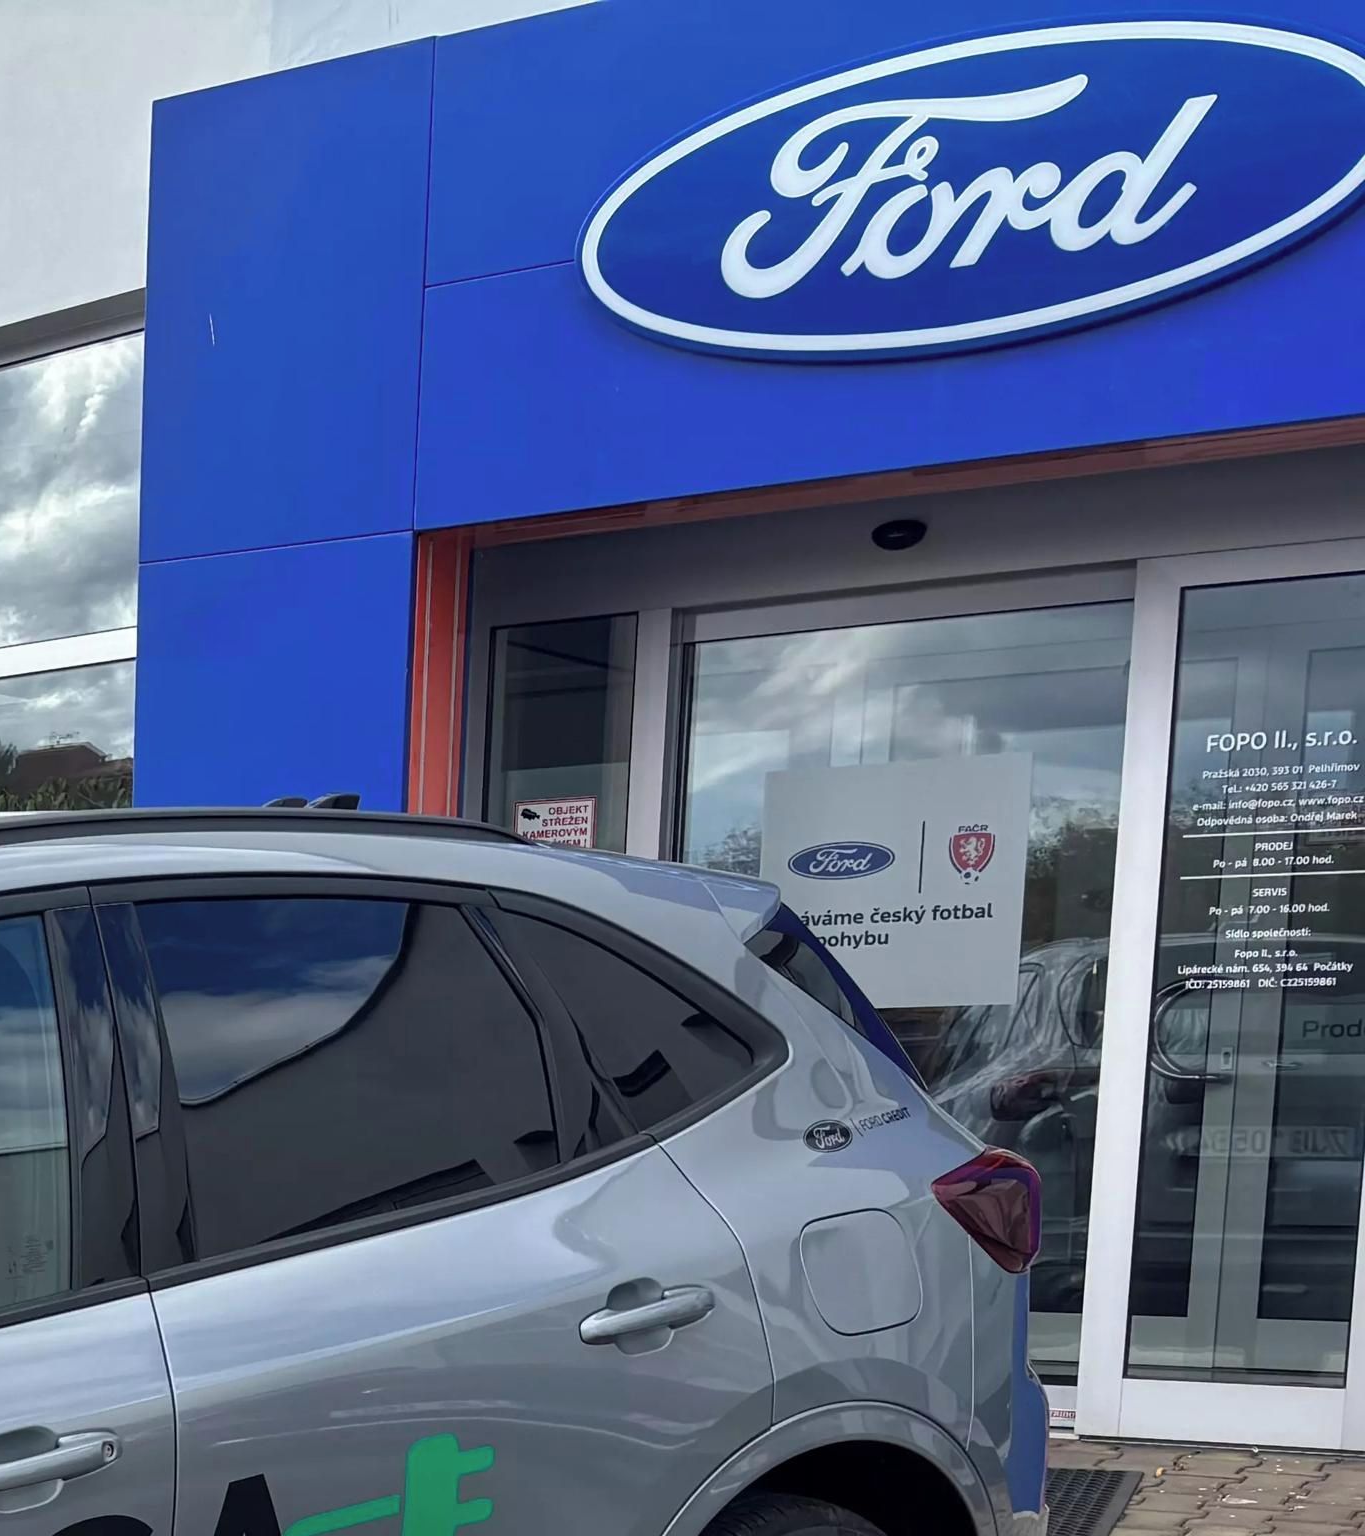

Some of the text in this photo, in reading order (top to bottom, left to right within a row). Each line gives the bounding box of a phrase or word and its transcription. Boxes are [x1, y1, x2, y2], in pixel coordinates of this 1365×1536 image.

[721, 74, 1217, 299] Ford
[1206, 731, 1267, 753] FOPO
[1305, 729, 1358, 747] s.r.o.
[1202, 762, 1361, 780] Pražská 2030, 393 01 Pelhřimov
[1221, 779, 1338, 794] Tel.: +420 565 321 426-7
[548, 805, 589, 815] OBJEKT
[1192, 801, 1226, 812] e-mail:
[1298, 794, 1365, 806] www.fopo.cz
[542, 816, 588, 827] STŘEŽEN
[1196, 811, 1358, 827] Odpovědná osoba: Ondřej Marek
[522, 826, 588, 840] KAMEROVÝM
[957, 824, 989, 833] FAČR
[1254, 841, 1294, 851] PRODEJ
[808, 848, 873, 874] Ford
[1213, 859, 1226, 869] Po
[1235, 859, 1248, 869] pá
[1253, 858, 1275, 867] 8.00
[1285, 856, 1310, 866] 17.00
[1312, 855, 1335, 865] hod.
[1252, 887, 1287, 897] SERVIS
[799, 902, 993, 926] áváme český fotbal
[1209, 907, 1222, 916] Po
[1231, 906, 1244, 916] pá
[1249, 904, 1270, 914] 7.00
[1280, 903, 1306, 913] 16.00
[1307, 903, 1330, 912] hod.
[1225, 928, 1250, 939] Sídlo
[1234, 950, 1259, 960] Fopo
[1274, 949, 1298, 958] s.r.o.
[1177, 961, 1354, 976] Lipárecké nám. 654, 394 64 Počátky
[1185, 977, 1337, 989] IČO: 25159861 DIČ: CZ25159861
[1302, 1018, 1365, 1038] Prod
[859, 1107, 911, 1132] FORD CREDIT
[813, 1125, 847, 1149] Ford
